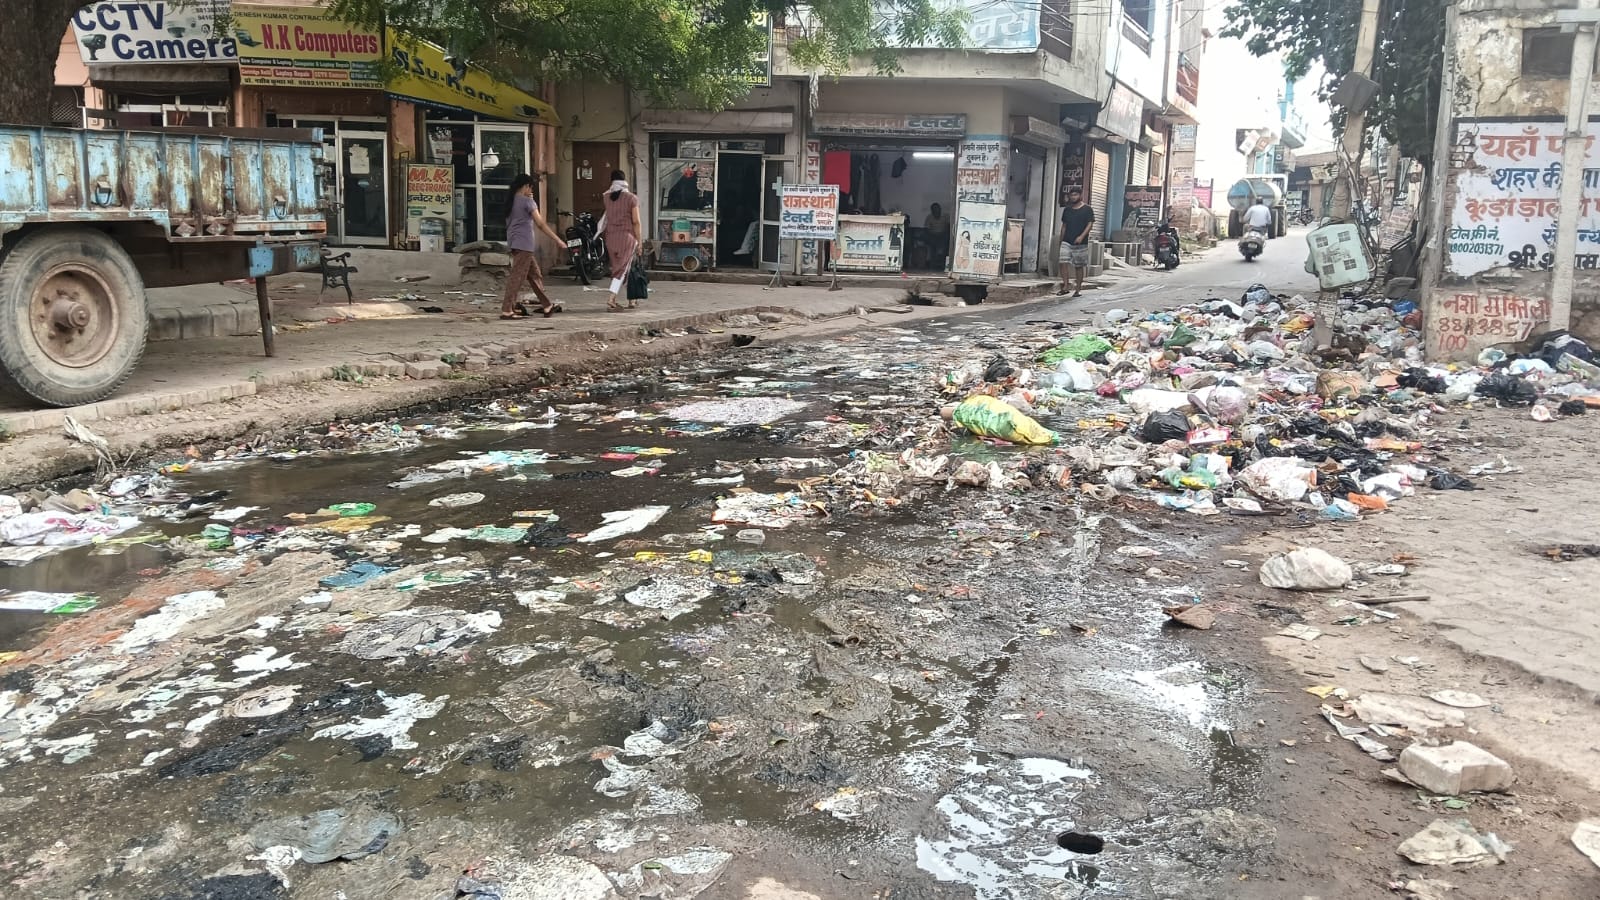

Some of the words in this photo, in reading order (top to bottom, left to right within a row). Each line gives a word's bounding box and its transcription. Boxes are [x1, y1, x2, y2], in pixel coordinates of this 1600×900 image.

[73, 3, 165, 31] CCTV
[263, 12, 287, 20] KUMAR
[112, 33, 238, 60] Camera
[261, 24, 292, 51] N.K
[294, 25, 378, 58] Computers
[1480, 125, 1541, 162] यहाँ
[1490, 166, 1541, 193] शहर
[783, 192, 837, 209] राजस्थानी
[783, 209, 815, 223] टेलर्स
[1438, 334, 1469, 352] 100
